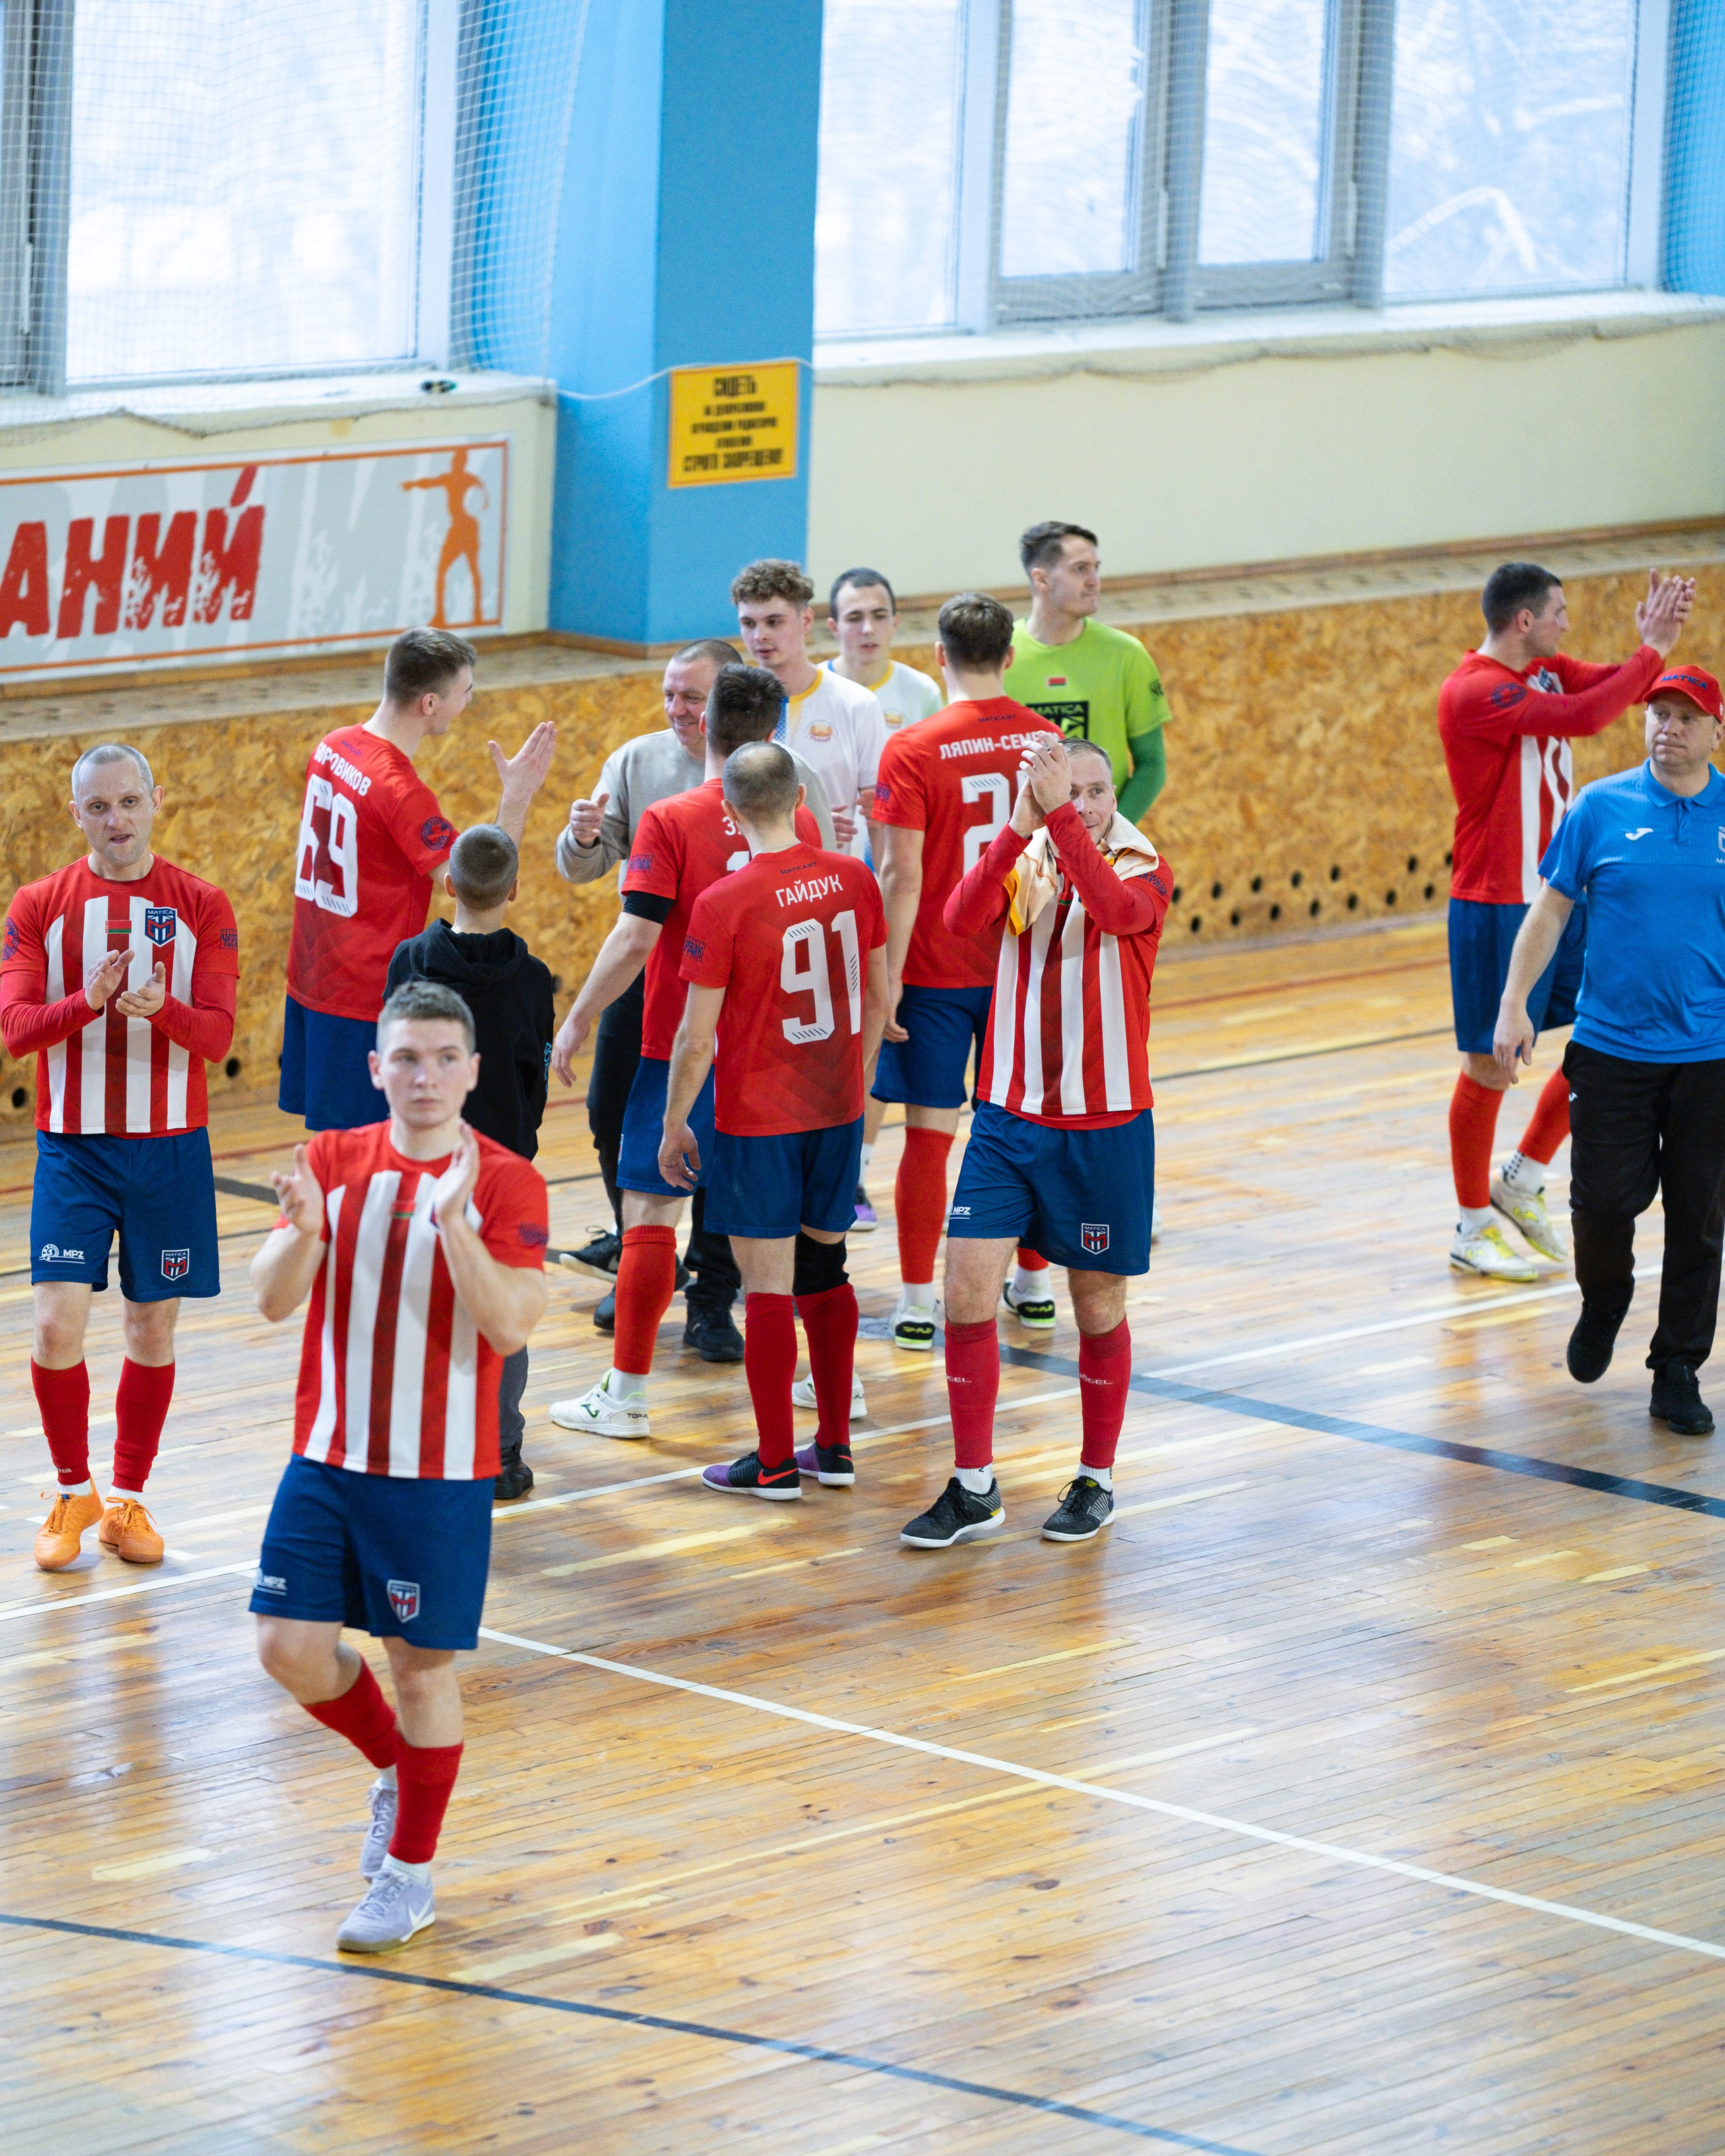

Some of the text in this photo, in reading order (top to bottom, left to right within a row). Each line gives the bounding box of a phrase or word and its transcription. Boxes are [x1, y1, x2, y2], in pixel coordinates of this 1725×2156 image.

[294, 773, 358, 918] 69
[775, 874, 844, 908] ГАЙДУК
[780, 909, 861, 1045] 91
[953, 1206, 972, 1215] MPZ
[63, 1249, 84, 1259] MPZ
